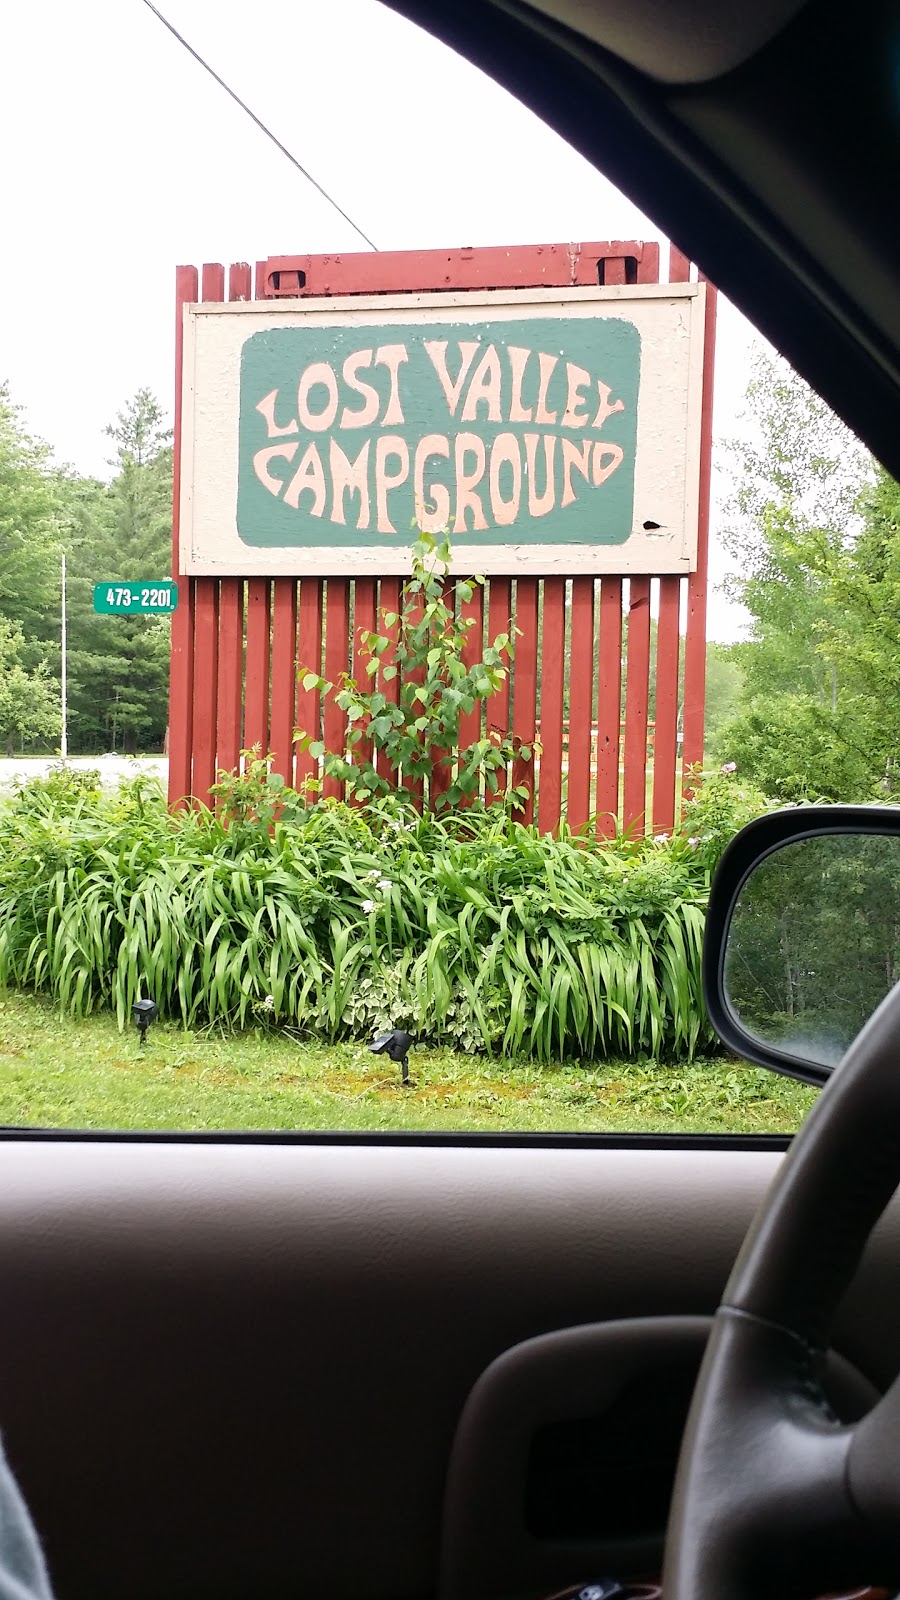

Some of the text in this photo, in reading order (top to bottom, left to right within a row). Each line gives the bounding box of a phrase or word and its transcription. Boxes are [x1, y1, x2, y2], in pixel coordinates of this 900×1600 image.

[256, 340, 625, 437] LOST VALLEY
[253, 431, 624, 534] CAMPGROUND
[106, 587, 171, 607] 473-2201
